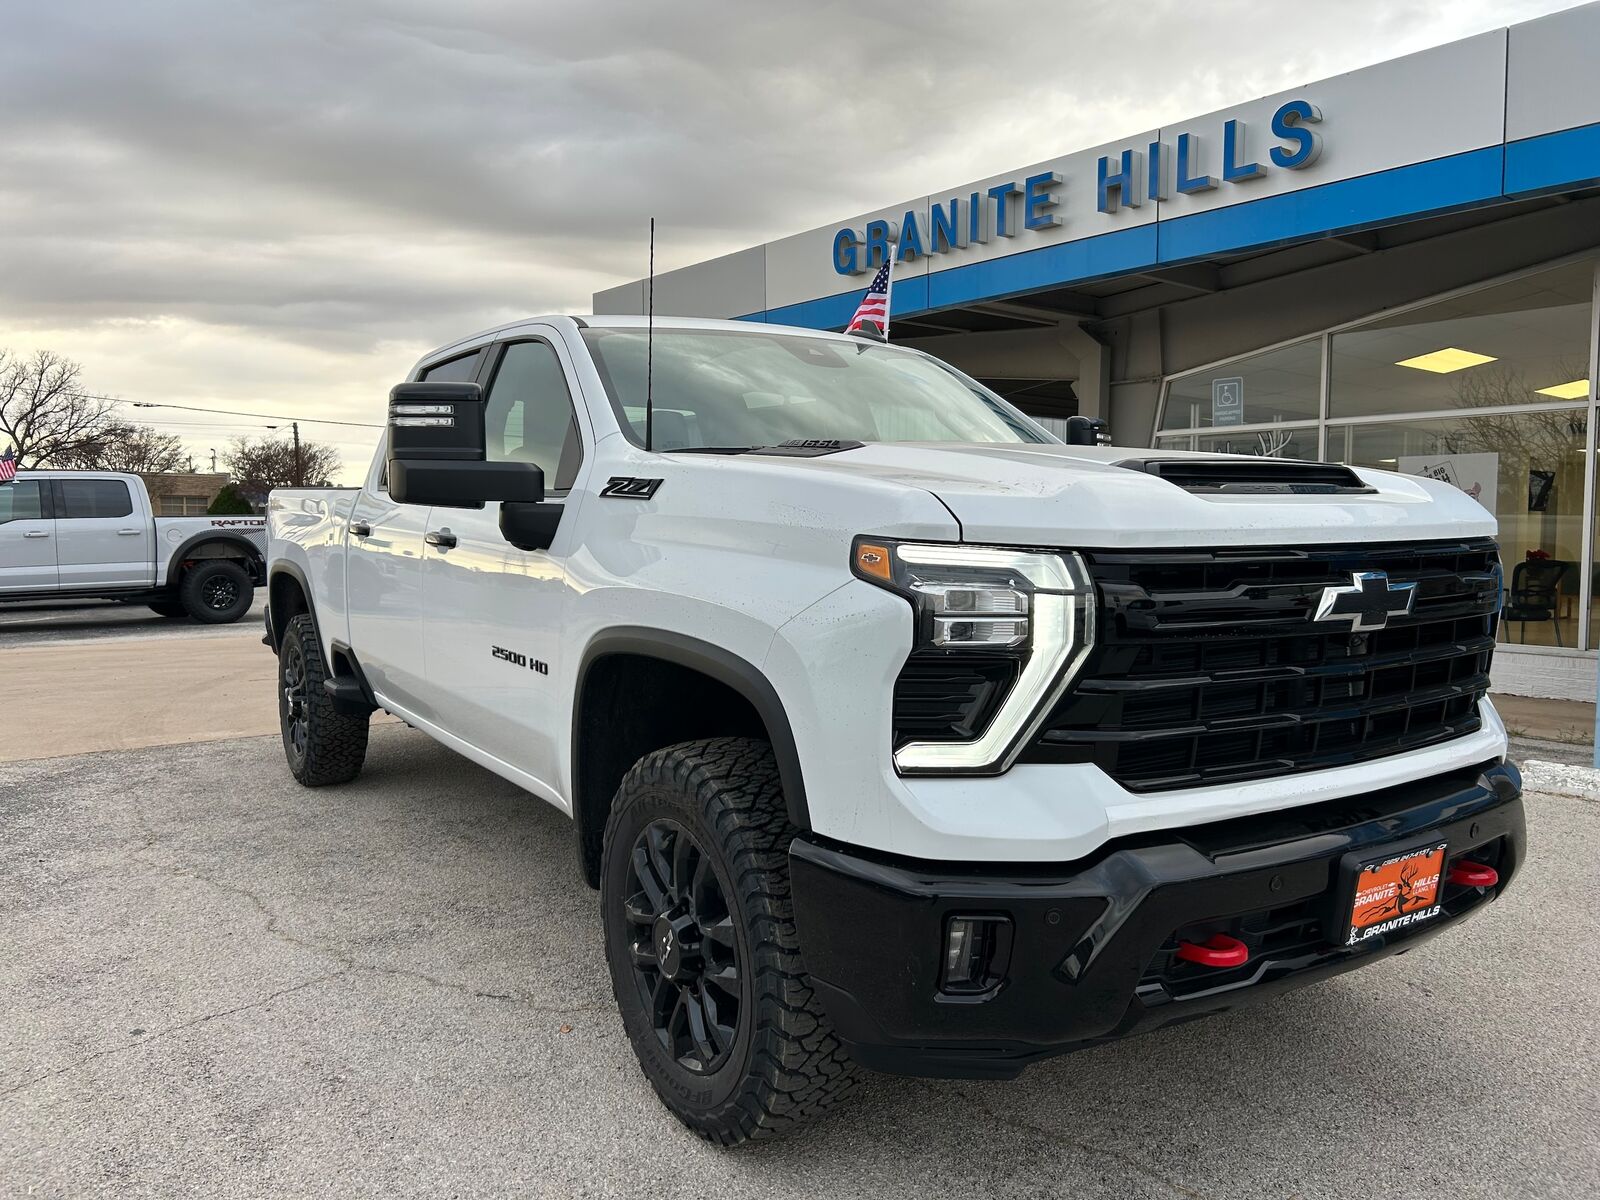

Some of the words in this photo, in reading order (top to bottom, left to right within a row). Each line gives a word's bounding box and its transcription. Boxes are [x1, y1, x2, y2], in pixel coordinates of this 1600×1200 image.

[833, 171, 1063, 276] GRANITE
[1097, 100, 1322, 214] HILLS
[1432, 466, 1446, 477] BIG
[598, 476, 665, 500] Z71
[491, 644, 527, 668] 2500
[529, 657, 549, 676] HD
[1413, 873, 1440, 888] HILLS
[1363, 916, 1411, 938] GRANITE
[1411, 905, 1441, 923] HILLS
